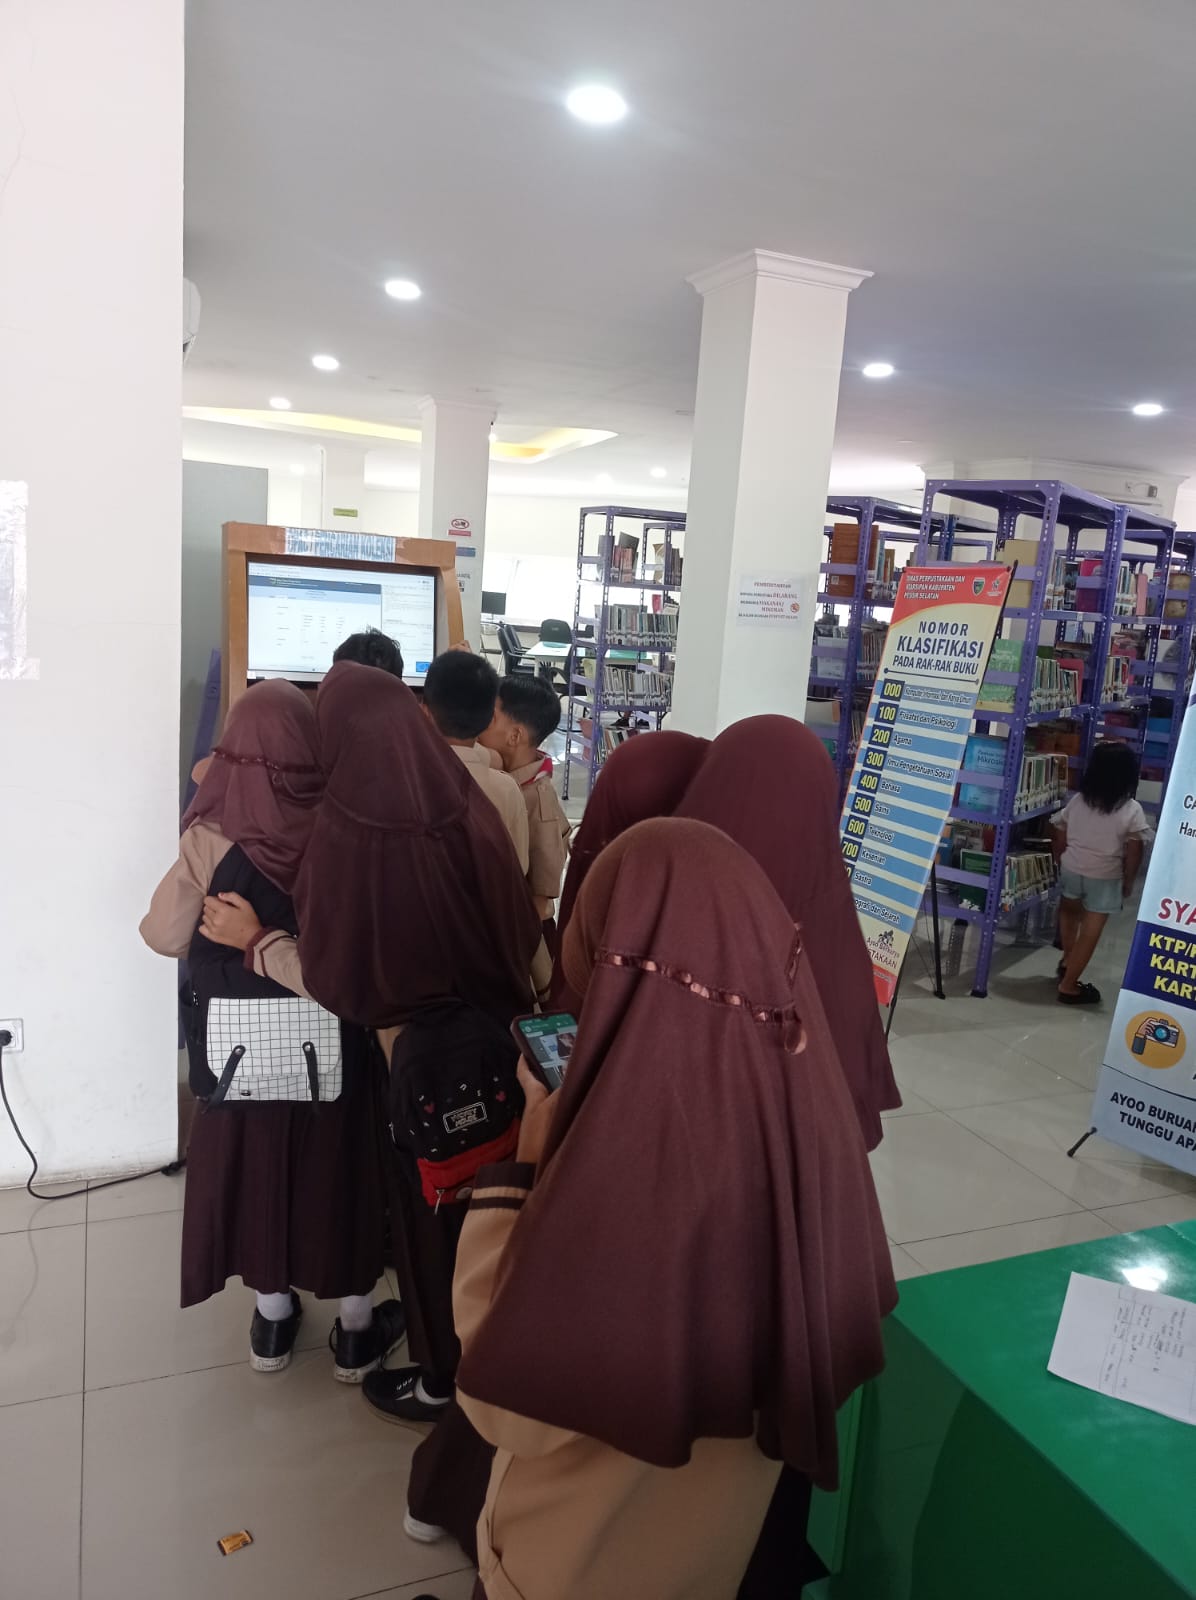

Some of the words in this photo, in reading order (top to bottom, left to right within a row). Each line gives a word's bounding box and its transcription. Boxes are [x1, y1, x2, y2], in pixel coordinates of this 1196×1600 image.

[919, 621, 969, 636] NOMOR
[897, 635, 984, 659] KLASIFIKASI
[892, 655, 914, 669] PADA
[915, 658, 953, 673] RAK-RAK
[953, 661, 979, 675] BUKU
[884, 683, 902, 697] 000
[880, 706, 896, 720] 100
[872, 729, 890, 744] 200
[894, 734, 912, 745] Agama
[867, 752, 884, 767] 300
[899, 761, 934, 775] Pengetahuan
[934, 768, 953, 780] Sosial
[861, 775, 878, 789] 400
[881, 781, 901, 793] Bahasa
[854, 797, 871, 812] 500
[875, 804, 889, 815] Sains
[848, 819, 865, 835] 600
[842, 841, 858, 857] 700
[855, 872, 872, 885] Sastra
[881, 908, 900, 923] Sejarah
[1110, 1091, 1145, 1112] AYOO
[1120, 1111, 1173, 1141] TUNGGU
